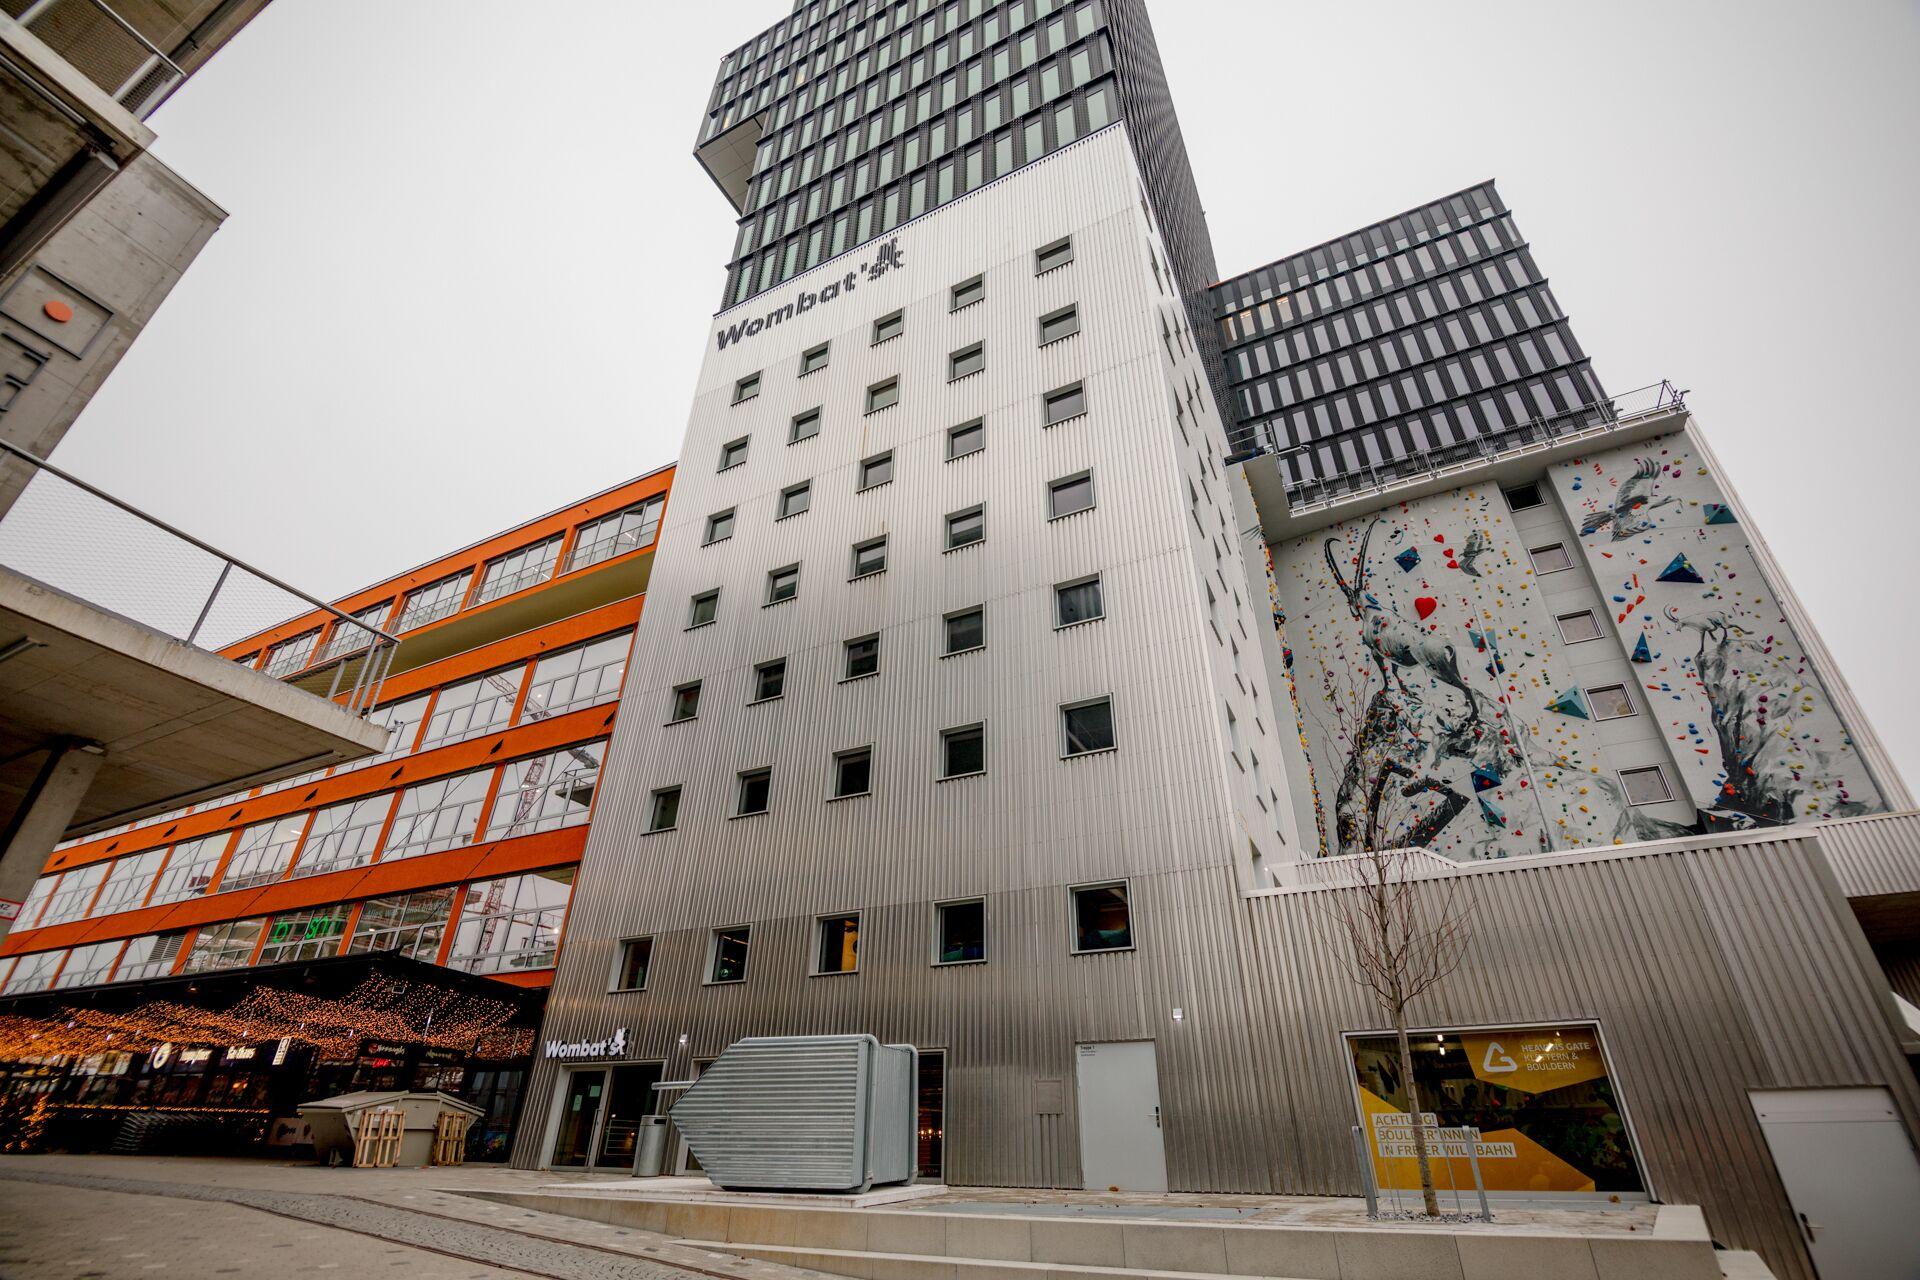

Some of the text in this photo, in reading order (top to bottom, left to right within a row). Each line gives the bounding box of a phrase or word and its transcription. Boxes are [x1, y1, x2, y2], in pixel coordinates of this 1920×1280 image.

[716, 255, 892, 351] Wombat's
[545, 1037, 620, 1058] Wombat's
[1521, 1042, 1591, 1052] HEAVNS GATE
[1527, 1062, 1576, 1071] BOULDERN
[1376, 1114, 1435, 1125] ACHTUG!
[1398, 1145, 1440, 1155] FREER
[1444, 1144, 1513, 1155] WILBAHN
